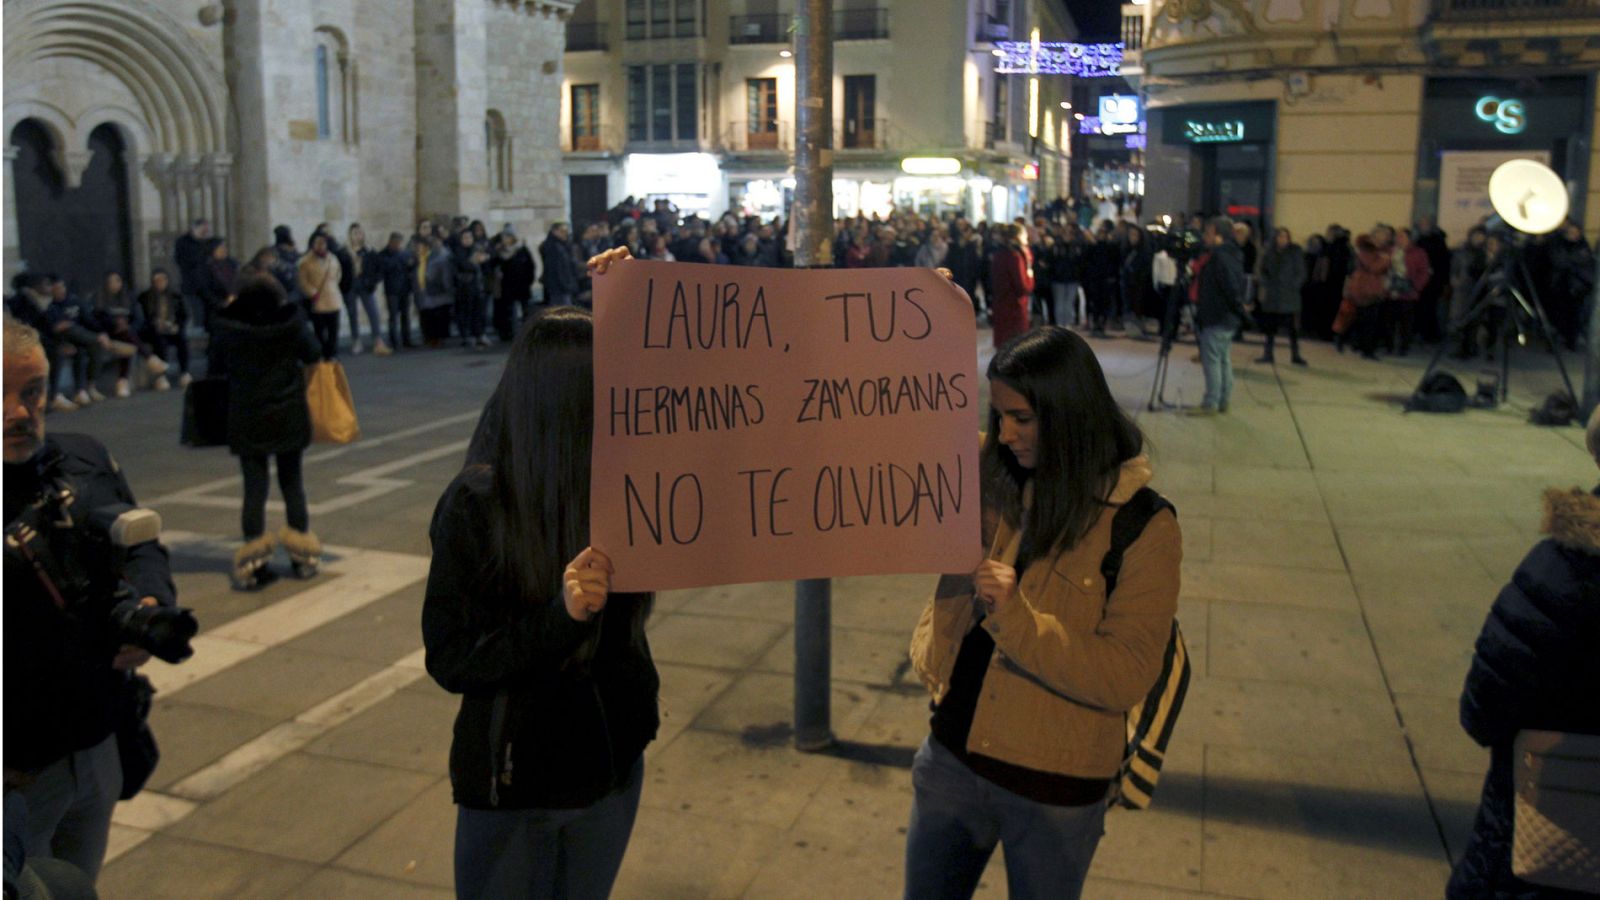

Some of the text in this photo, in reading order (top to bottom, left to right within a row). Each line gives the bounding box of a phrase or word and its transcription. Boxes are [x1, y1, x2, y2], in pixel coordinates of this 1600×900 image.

[643, 278, 932, 353] LAURA, TUS
[610, 372, 968, 436] HERMANAS ZAMORANAS
[624, 471, 703, 547] NO
[738, 467, 793, 537] TE
